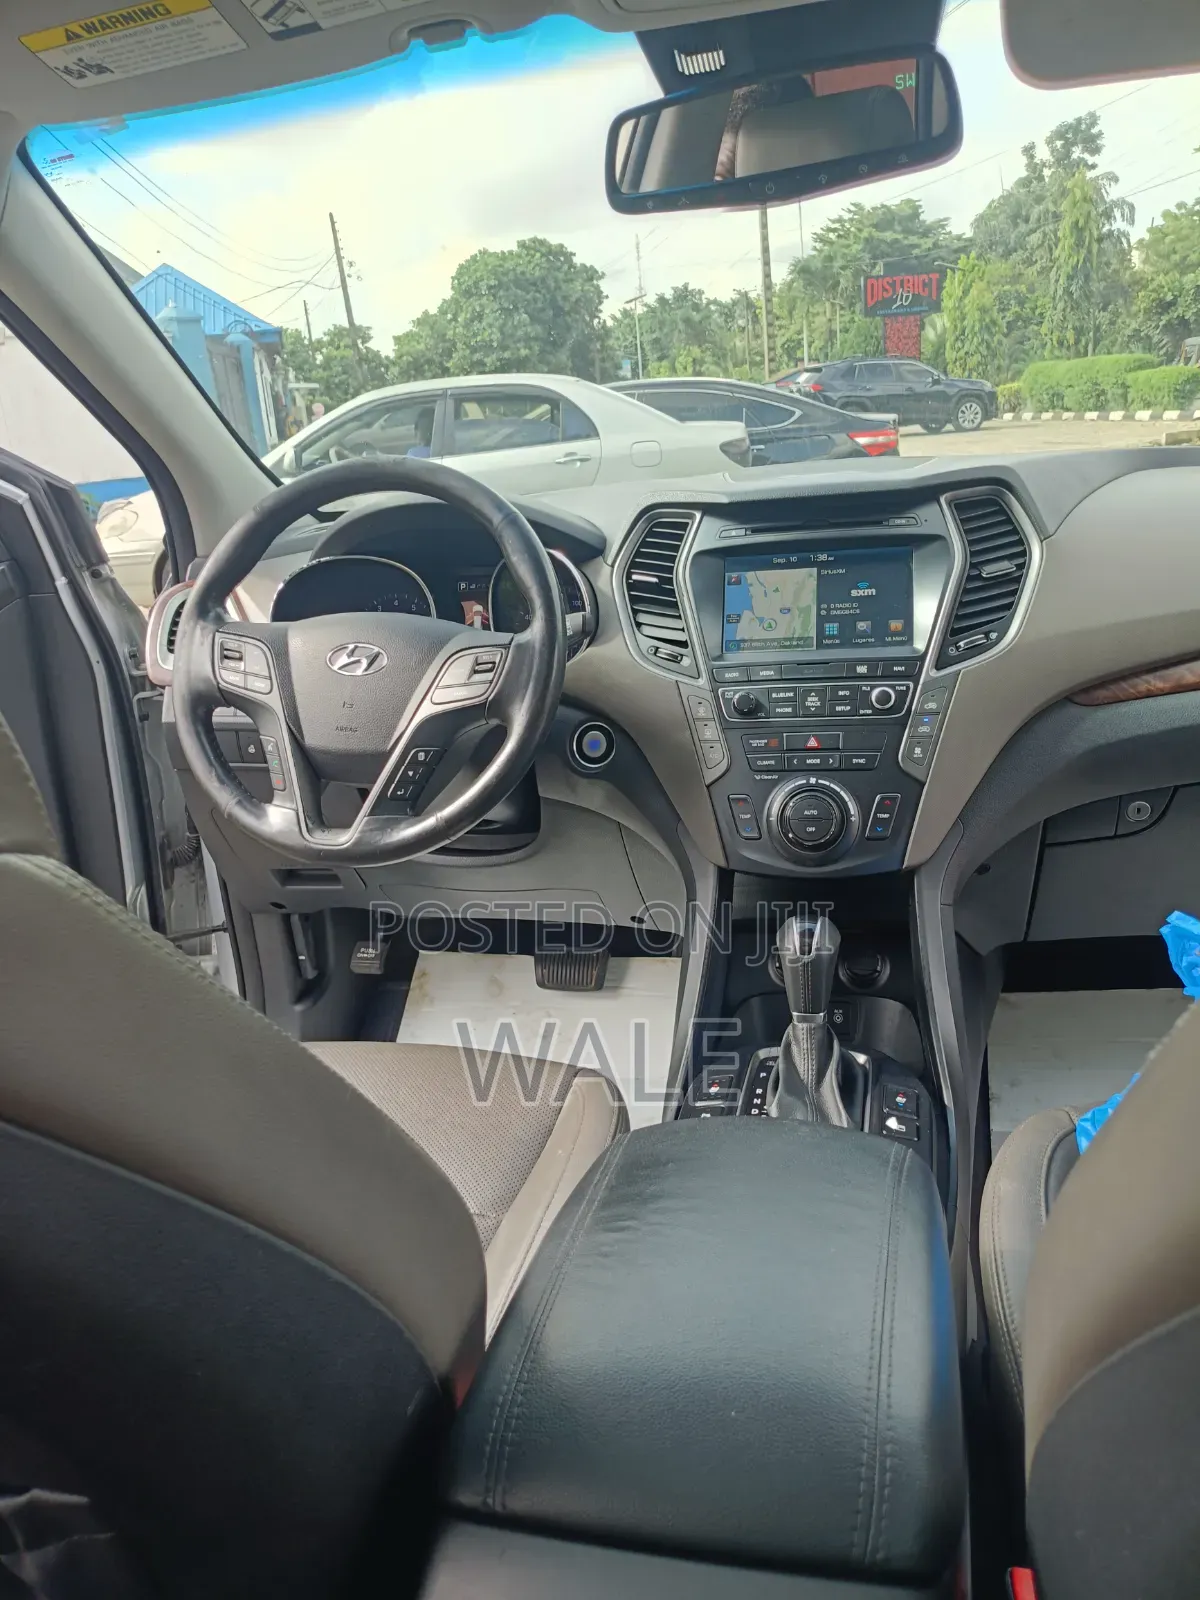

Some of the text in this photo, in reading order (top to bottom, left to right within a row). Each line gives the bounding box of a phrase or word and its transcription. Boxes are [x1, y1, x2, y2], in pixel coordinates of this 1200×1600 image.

[79, 3, 172, 36] WARNING
[895, 72, 915, 90] SW
[866, 273, 940, 308] DISTRICT
[892, 287, 912, 310] 10
[772, 557, 788, 565] Sep.
[790, 555, 798, 563] 10
[809, 554, 828, 562] 1:38
[850, 587, 876, 597] sxm
[852, 636, 875, 644] Lugares
